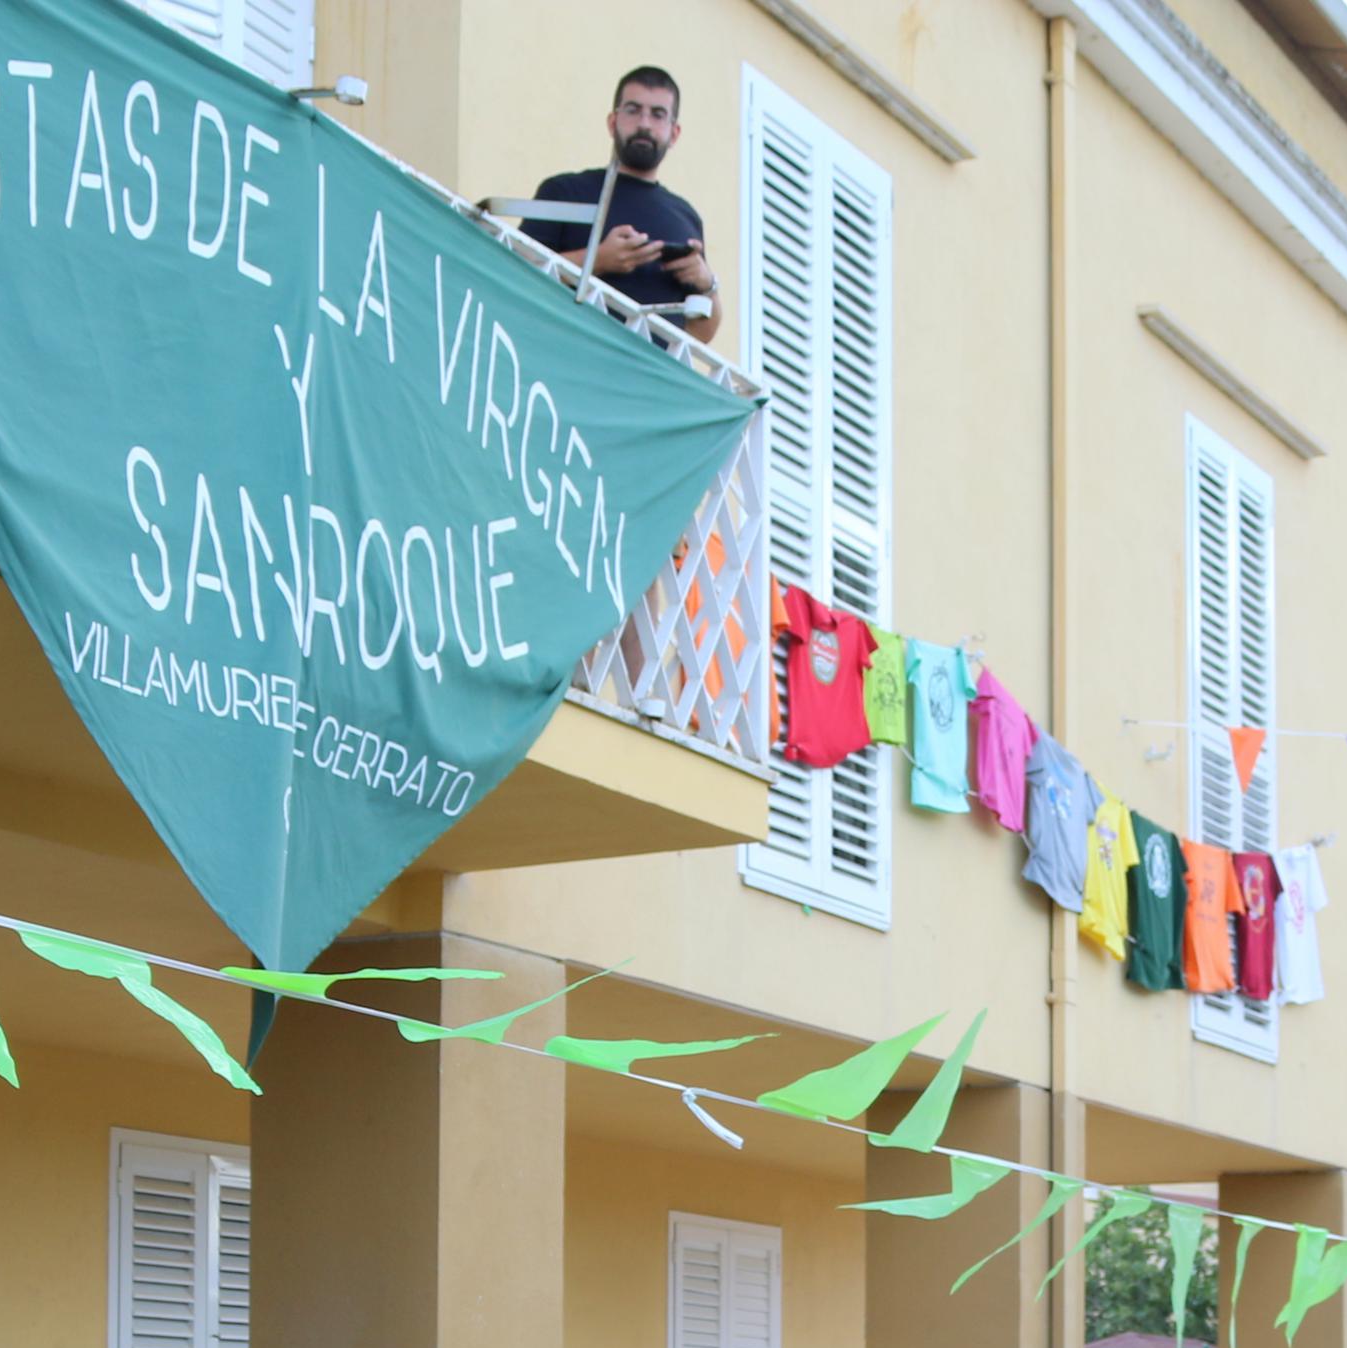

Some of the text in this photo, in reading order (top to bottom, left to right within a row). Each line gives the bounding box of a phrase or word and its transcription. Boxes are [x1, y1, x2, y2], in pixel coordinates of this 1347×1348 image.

[187, 99, 281, 287] DE
[318, 163, 395, 363] LA
[434, 253, 626, 624] VIRGEN
[273, 324, 315, 477] Y
[312, 715, 476, 817] CERRATO
